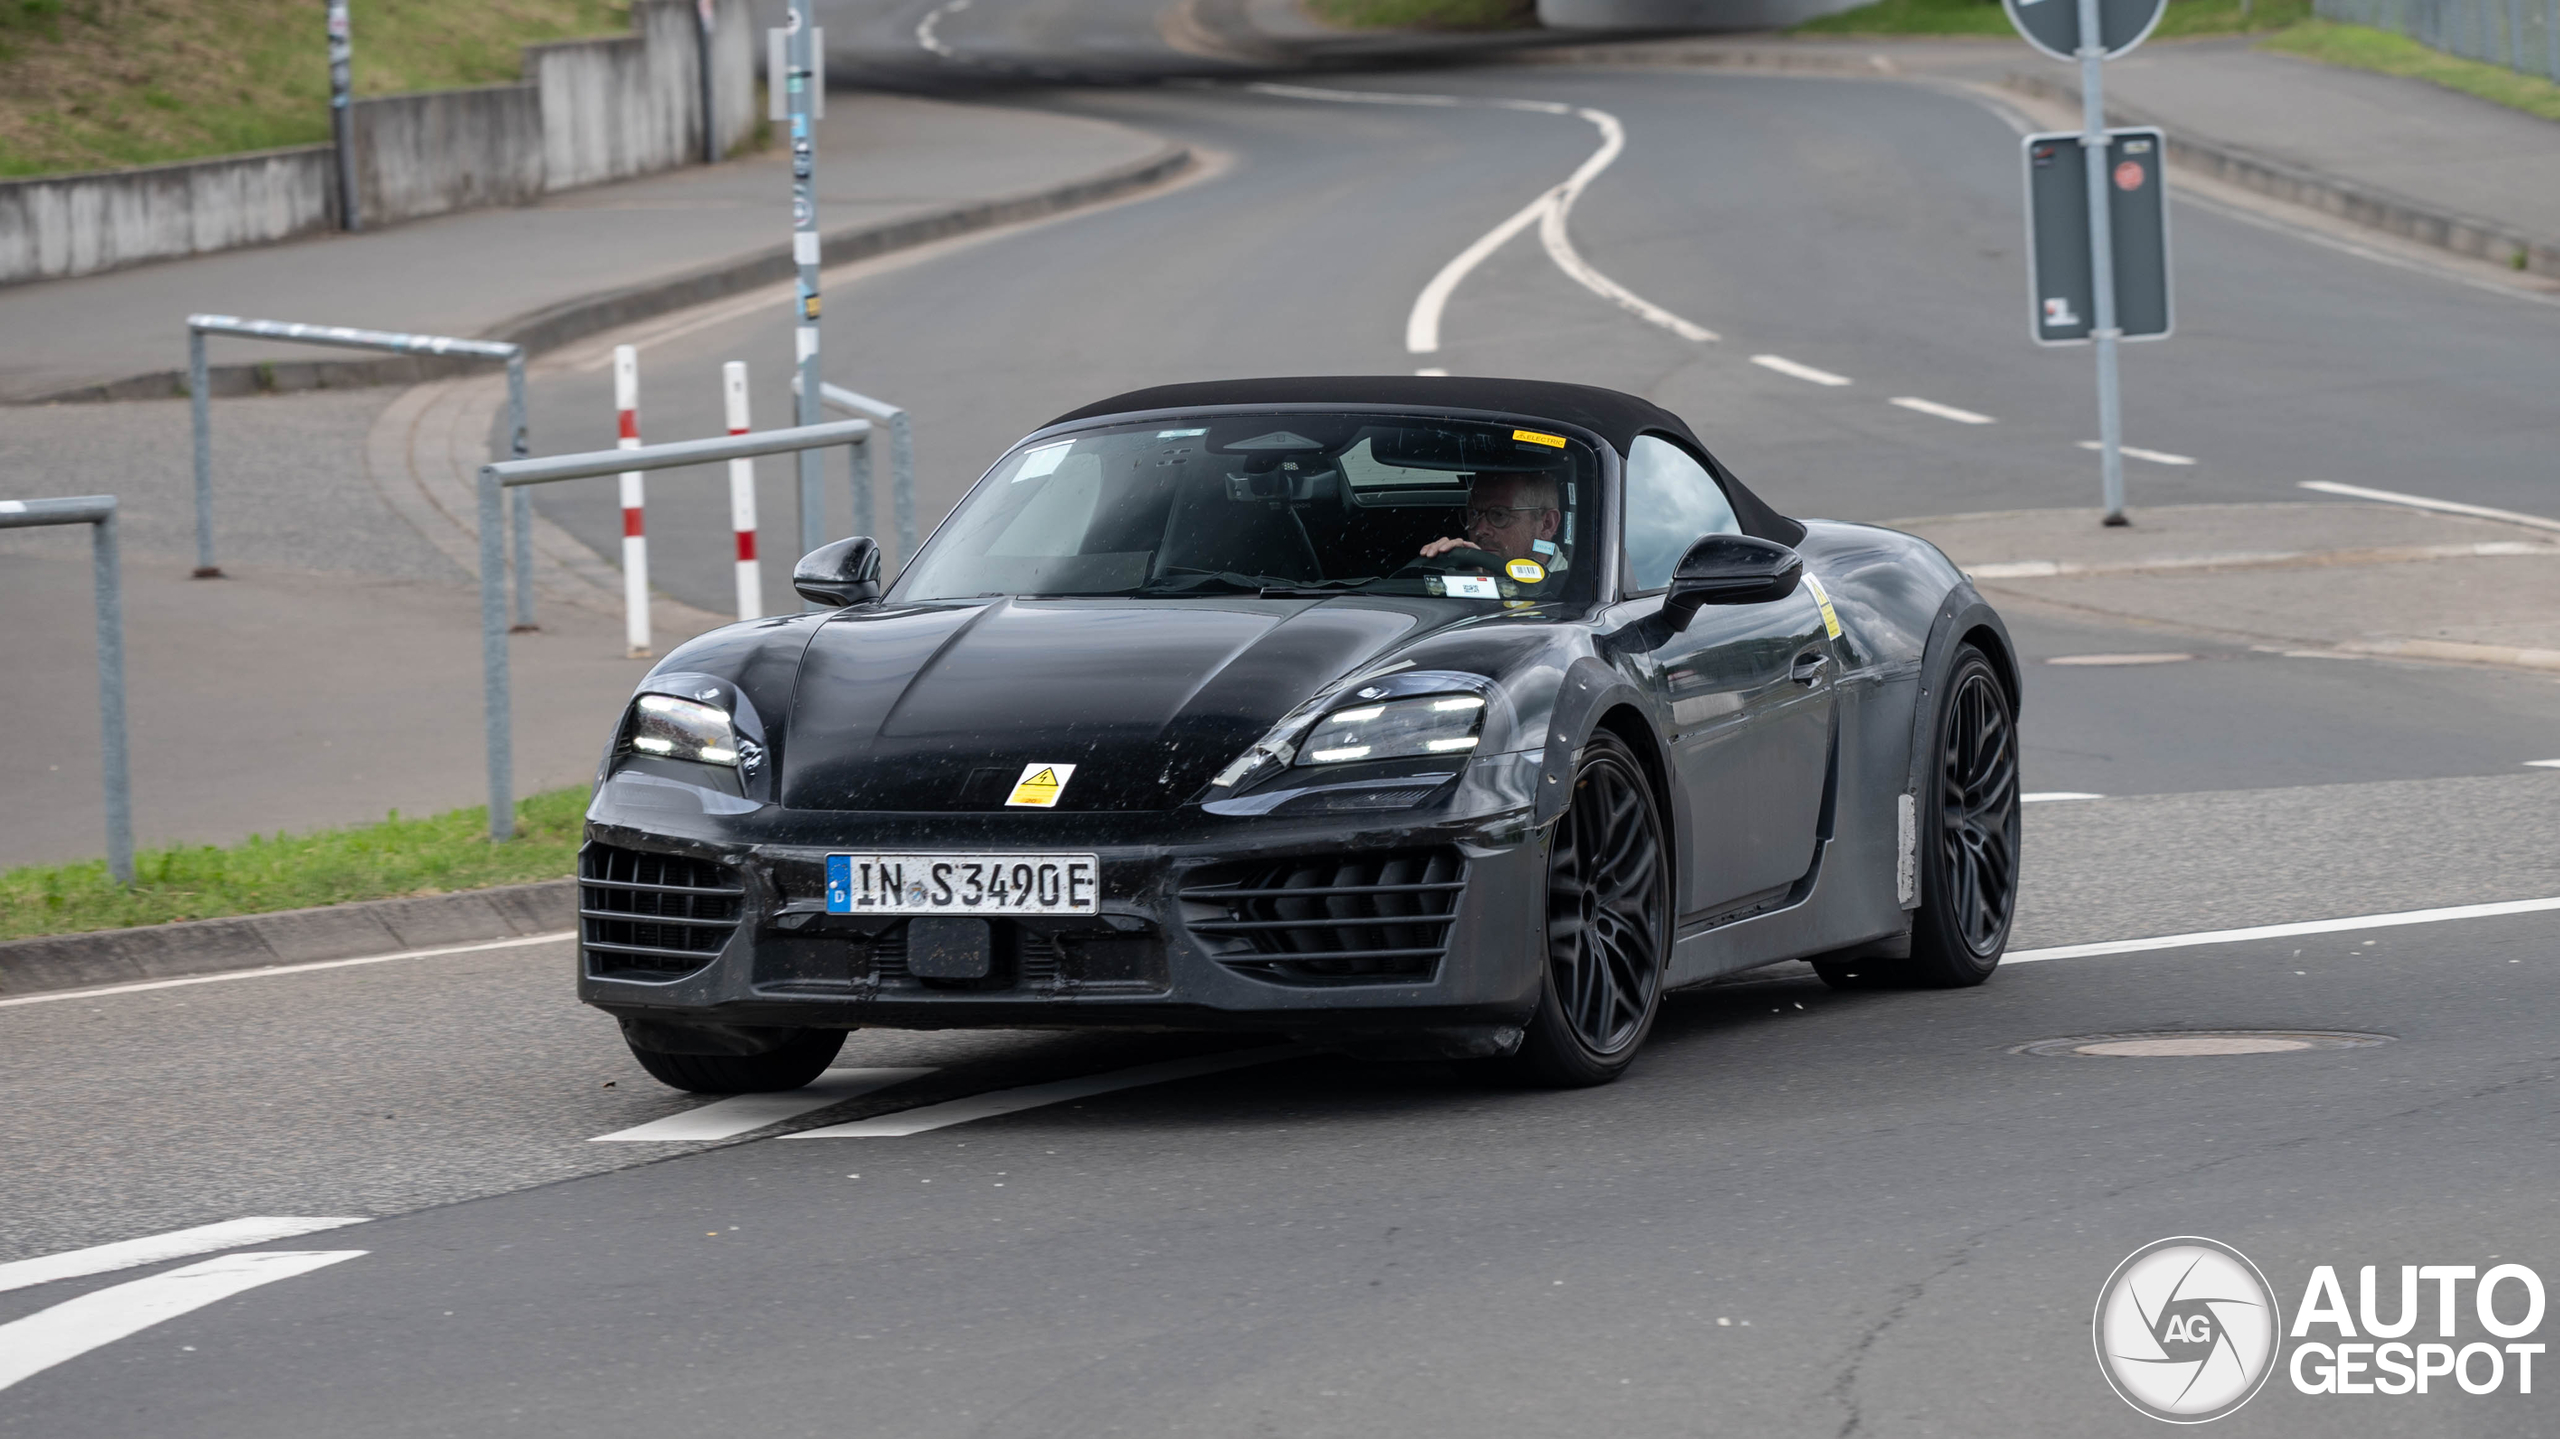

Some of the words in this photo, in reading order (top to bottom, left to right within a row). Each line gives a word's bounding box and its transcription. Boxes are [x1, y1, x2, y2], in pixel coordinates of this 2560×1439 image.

[1526, 434, 1564, 446] ELECTRIC
[857, 863, 902, 906] IN
[931, 863, 1091, 906] S3490E
[834, 890, 845, 903] D
